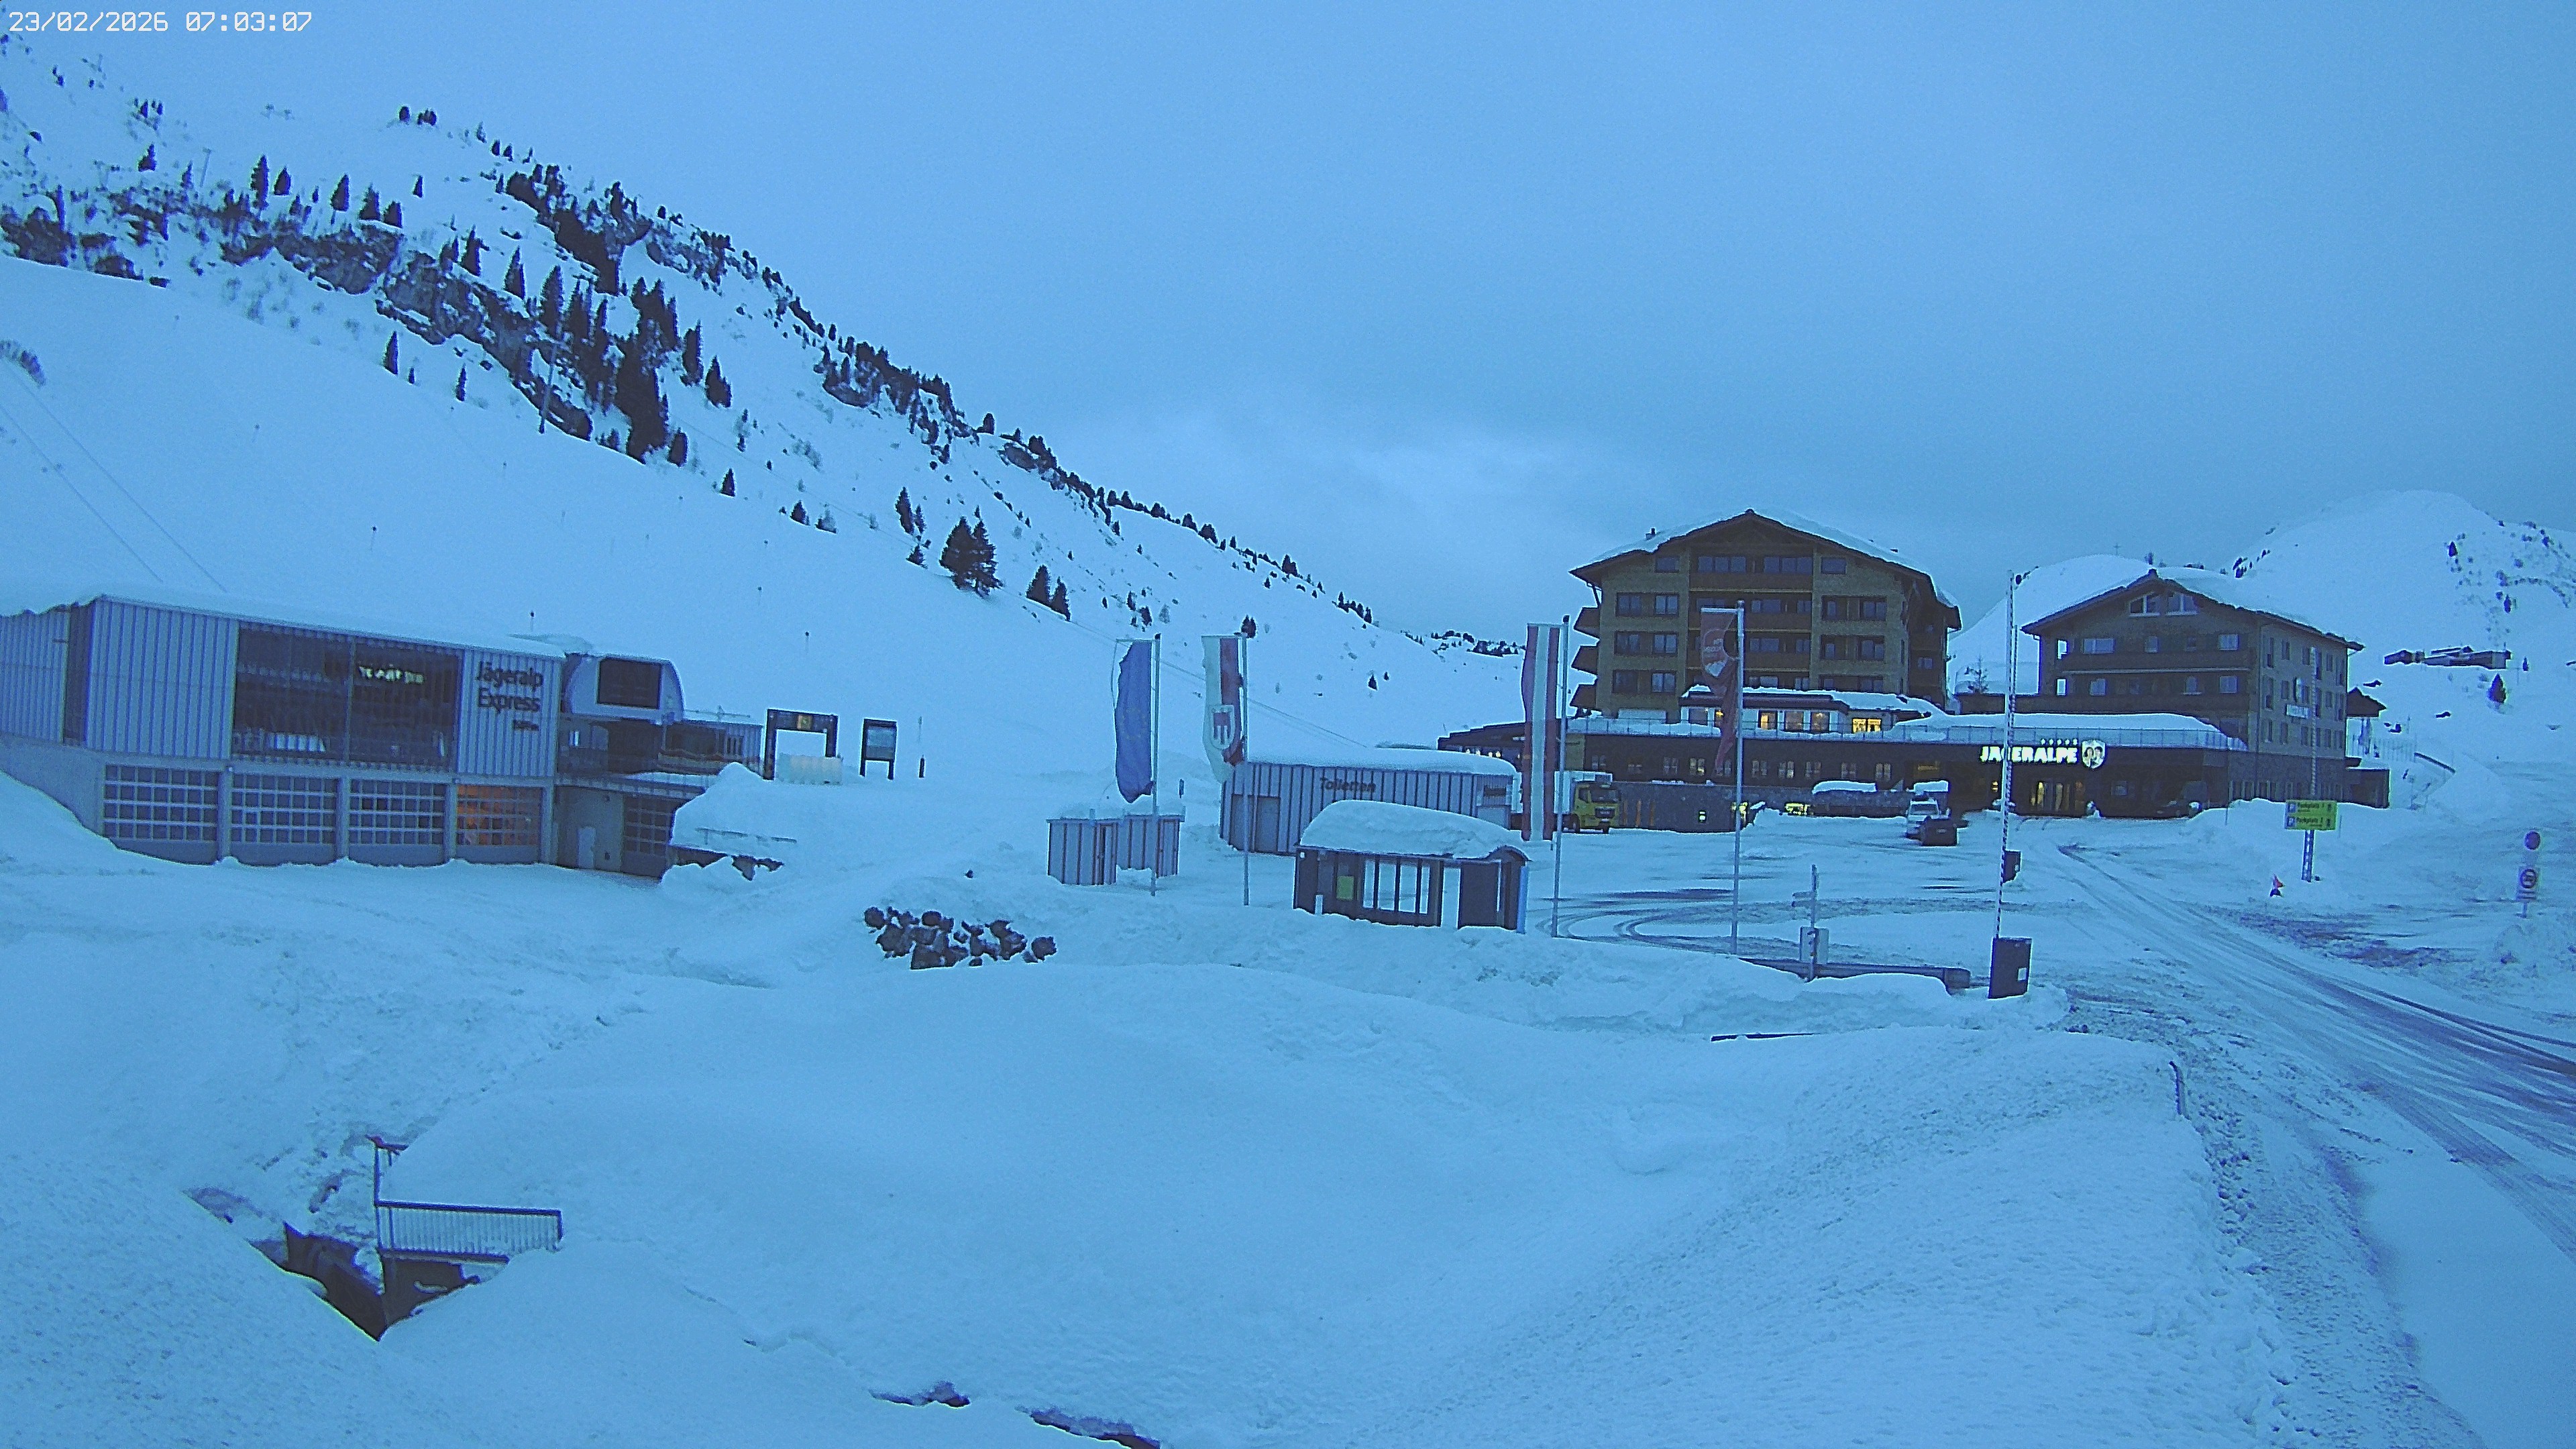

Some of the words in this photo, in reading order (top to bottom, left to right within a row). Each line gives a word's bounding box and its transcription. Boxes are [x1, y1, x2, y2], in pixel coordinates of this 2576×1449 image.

[476, 660, 544, 692] Jägeralp
[478, 687, 541, 714] Express
[1320, 777, 1377, 793] Toiletten
